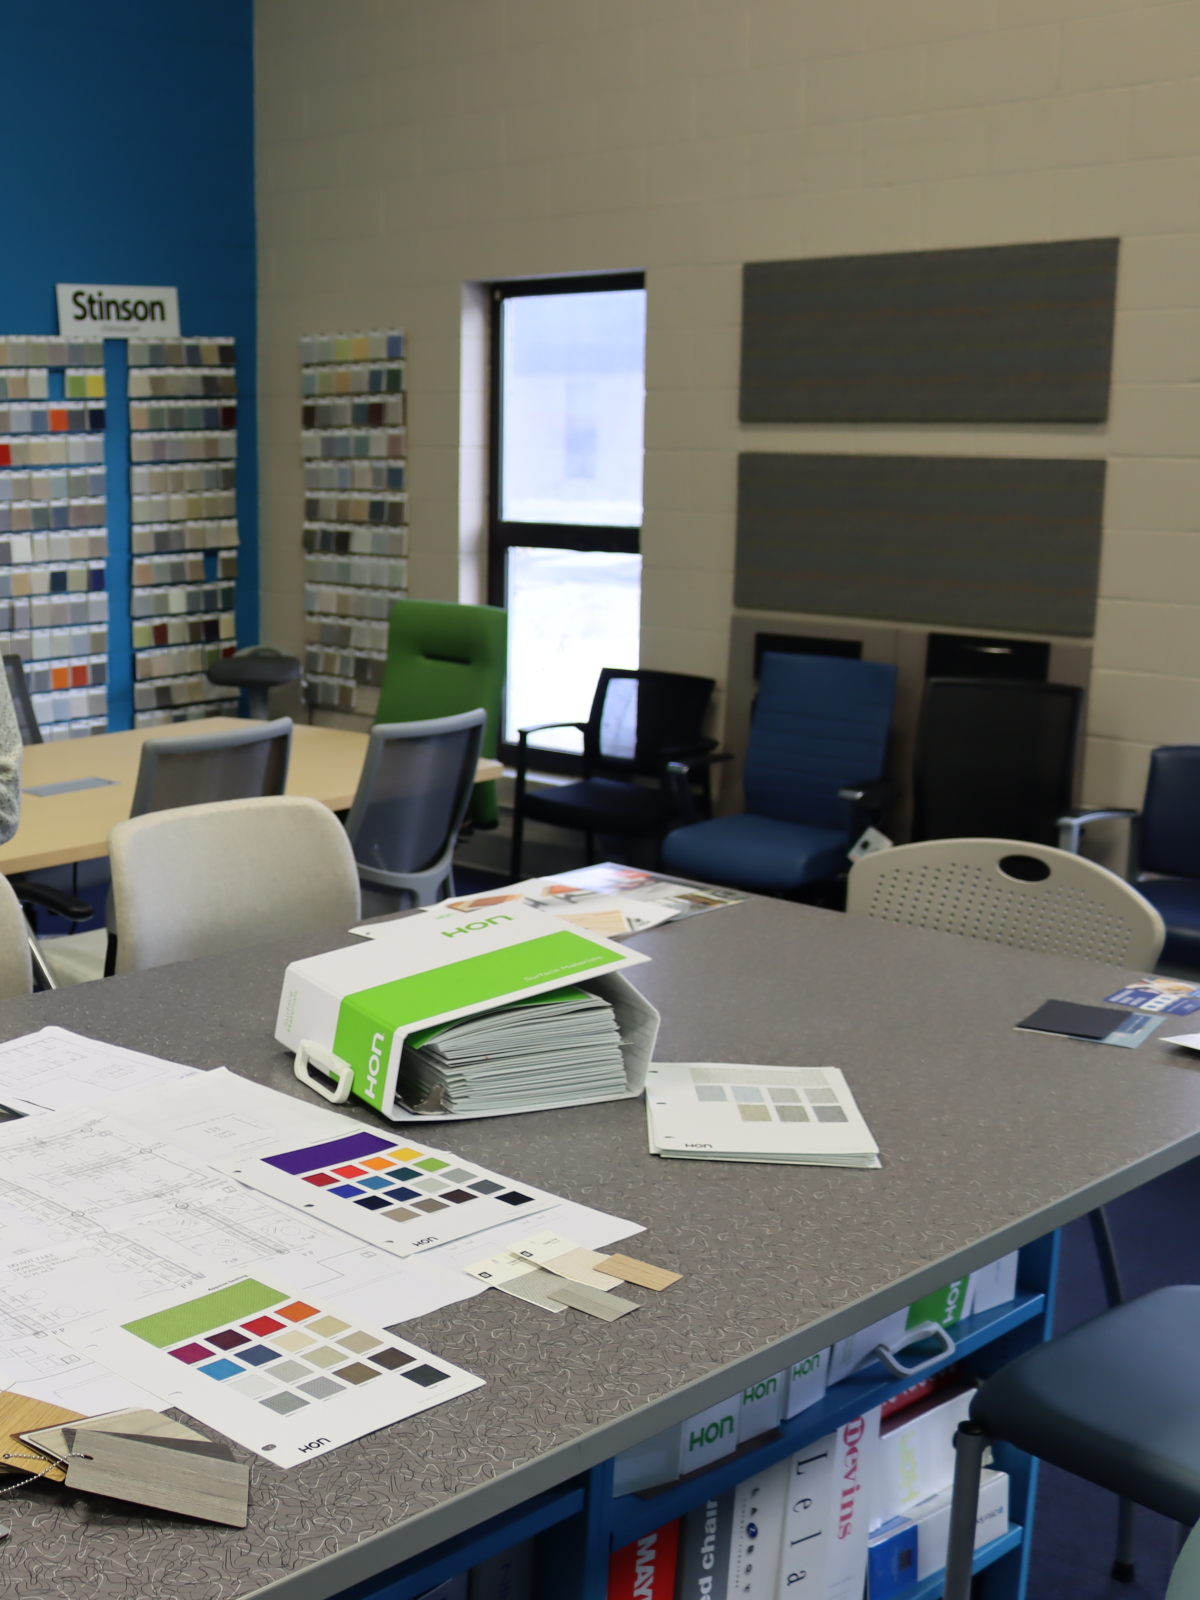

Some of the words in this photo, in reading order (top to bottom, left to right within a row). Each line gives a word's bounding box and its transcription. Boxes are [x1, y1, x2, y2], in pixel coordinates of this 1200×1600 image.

[71, 290, 166, 322] Stinson
[523, 967, 560, 982] Surface
[560, 955, 604, 970] Materials
[364, 1032, 385, 1099] HON
[297, 1437, 332, 1453] HON
[689, 1415, 735, 1451] HON
[837, 1416, 866, 1540] Devins
[701, 1500, 719, 1571] chair
